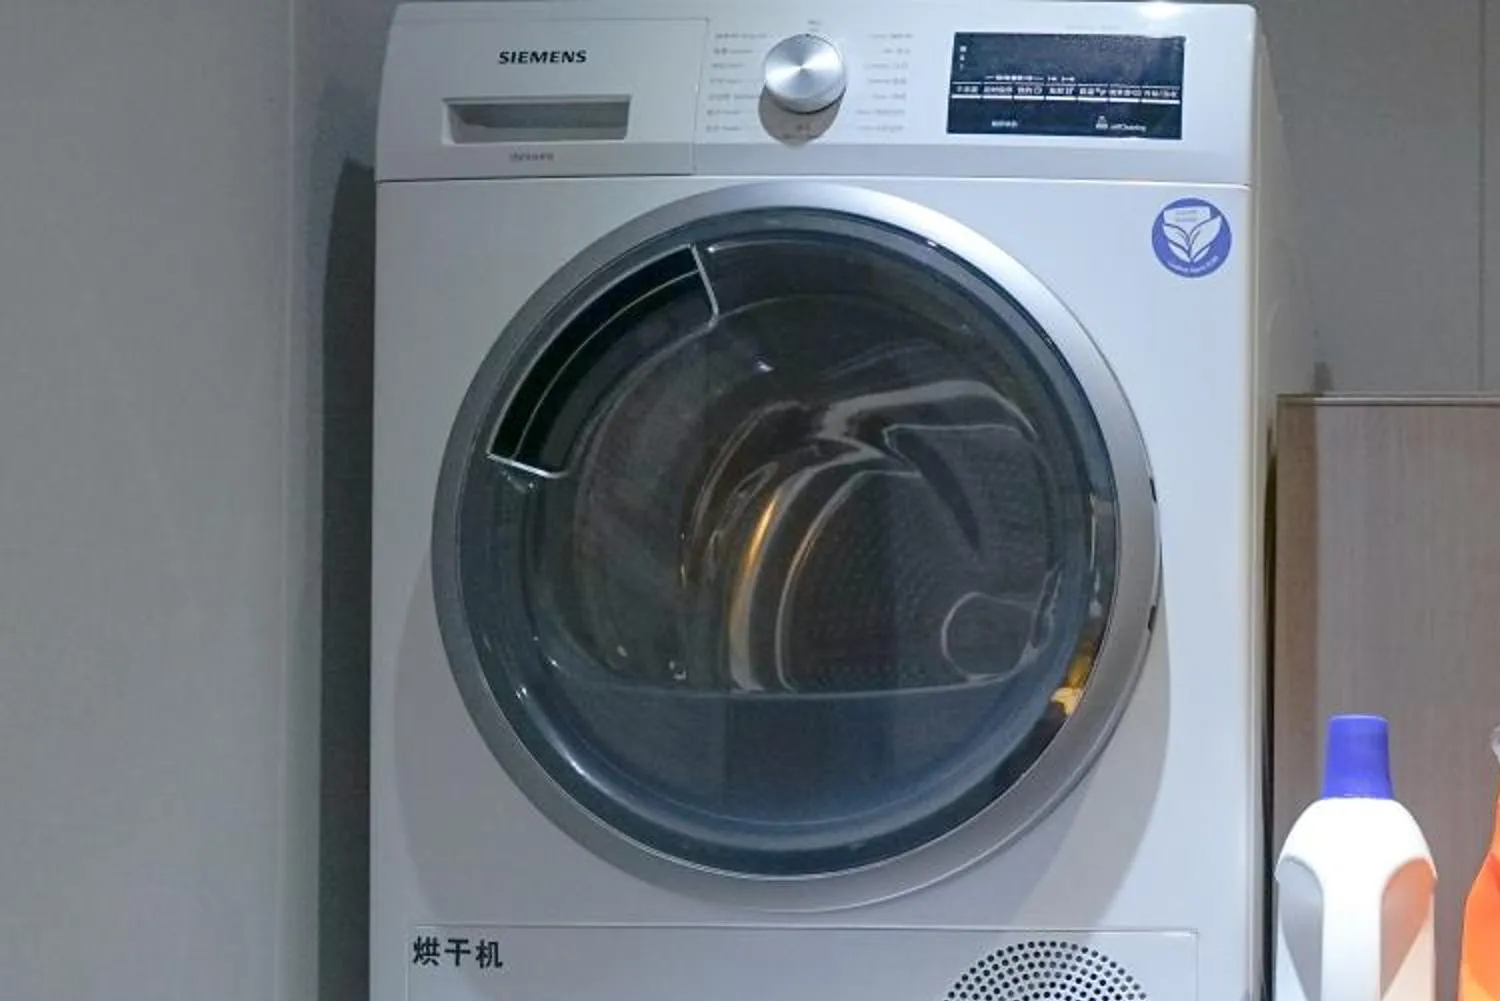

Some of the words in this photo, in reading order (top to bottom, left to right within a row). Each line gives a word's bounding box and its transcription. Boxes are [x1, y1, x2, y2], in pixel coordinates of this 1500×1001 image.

[499, 50, 587, 65] SIEMENS
[412, 935, 503, 969] 烘干机
